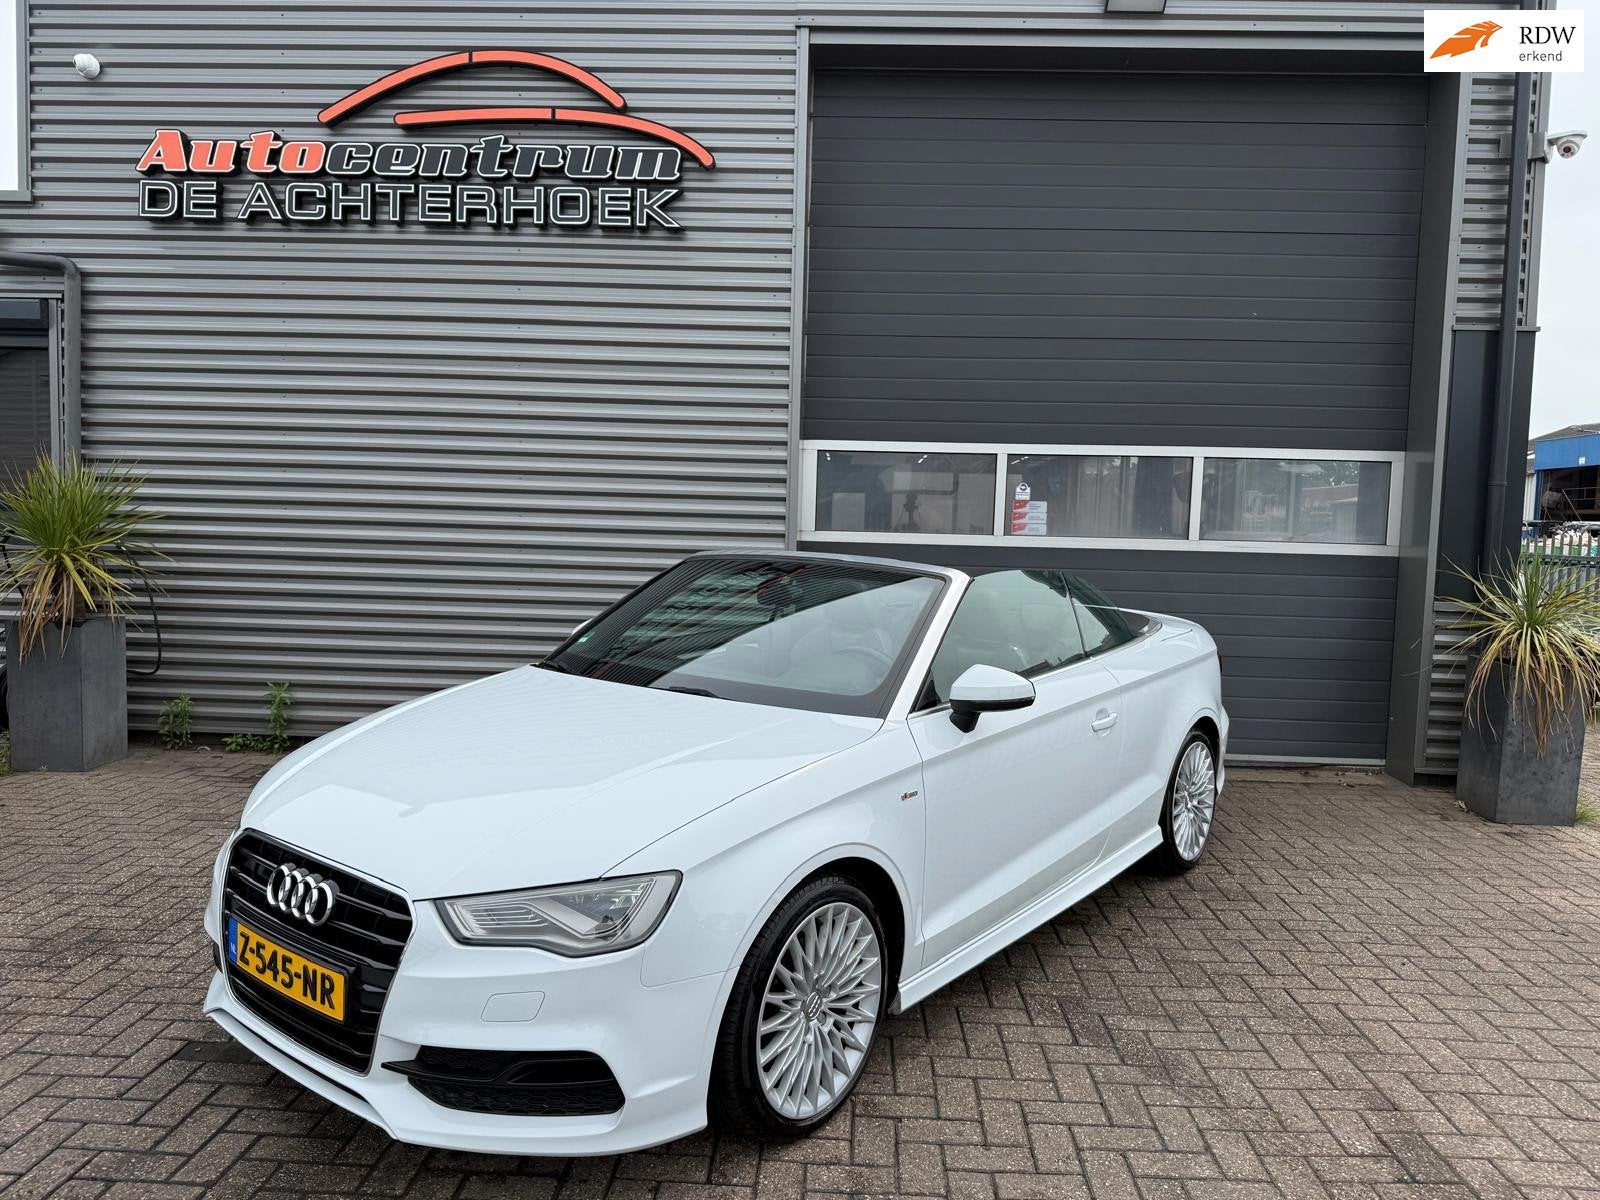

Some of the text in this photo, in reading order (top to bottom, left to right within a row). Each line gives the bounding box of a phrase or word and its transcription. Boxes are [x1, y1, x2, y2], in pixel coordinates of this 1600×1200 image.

[135, 128, 682, 182] Autocentrum
[138, 179, 683, 229] DE ACHTERHOEK
[238, 930, 336, 1011] Z-545-NR
